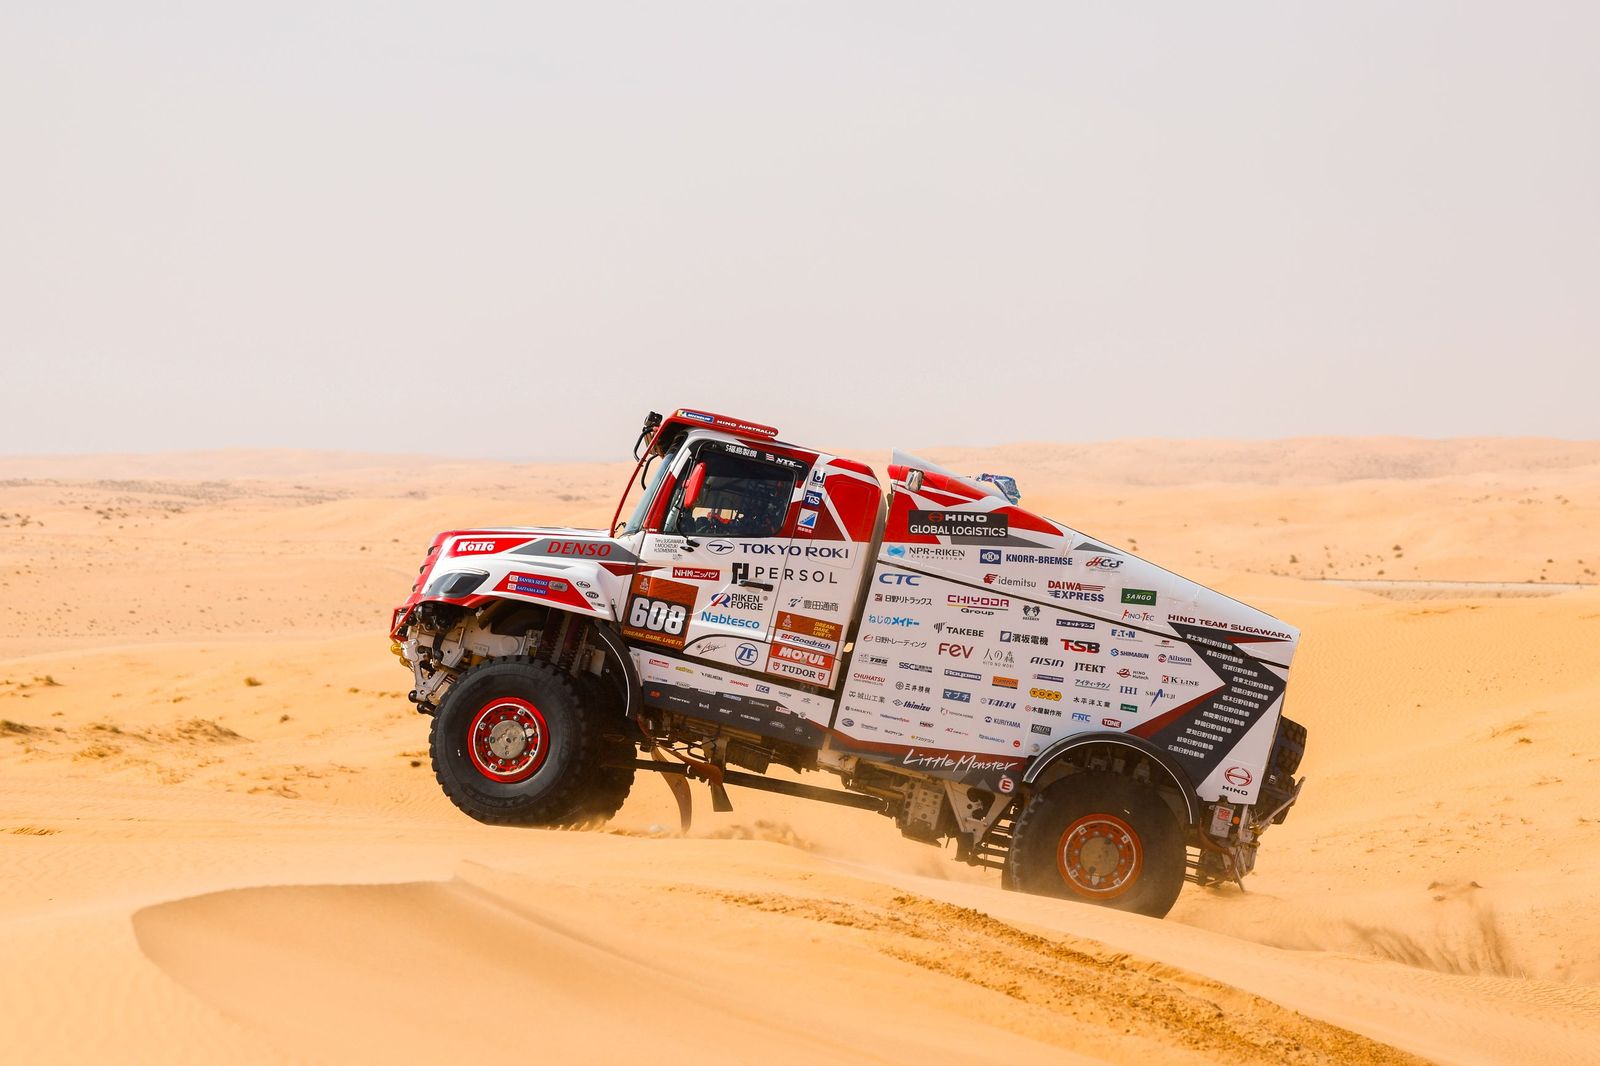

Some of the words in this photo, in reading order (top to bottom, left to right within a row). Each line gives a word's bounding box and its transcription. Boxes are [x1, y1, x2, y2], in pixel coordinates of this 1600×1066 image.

[717, 419, 737, 427] HINO
[738, 424, 776, 435] AUSTRALIA
[945, 514, 988, 522] HINO
[910, 524, 950, 535] GLOBAL
[951, 526, 1006, 537] LOGISTICS
[547, 540, 612, 557] DENSO
[739, 542, 802, 556] TOKYO
[806, 546, 849, 559] ROKI
[909, 547, 966, 557] NPR-RIKEN
[1006, 554, 1073, 566] KNORR-BREMSE
[755, 566, 838, 584] PERSOL
[879, 573, 922, 586] CTC
[998, 576, 1036, 588] idemitsu
[1048, 580, 1082, 591] DAIWA
[732, 593, 760, 603] RIKEN
[947, 594, 1009, 607] CHIYODA
[1054, 590, 1104, 602] EXPRESS
[730, 600, 763, 611] FORGE
[630, 597, 686, 634] 608
[701, 611, 760, 629] Nabtesco
[868, 615, 920, 627] ねじのメイドー
[946, 626, 984, 637] TAKEBE
[1168, 614, 1195, 623] HINO
[1199, 618, 1227, 629] TEAM
[1231, 624, 1292, 640] SUGAWARA
[623, 630, 644, 638] DREAM.
[1060, 639, 1100, 654] TSB
[738, 647, 757, 660] ZF
[778, 647, 825, 666] MOTUL
[1168, 655, 1192, 663] Allison
[899, 662, 915, 670] SSC
[1030, 656, 1064, 667] AISIN
[1074, 662, 1106, 673] JTEKT
[782, 664, 816, 678] TUDOR
[854, 672, 885, 682] CHUHATSU
[1120, 686, 1137, 695] IHI
[904, 700, 931, 712] Shimizu
[994, 718, 1021, 728] KURIYAMA
[1103, 719, 1120, 727] TONE
[903, 748, 956, 768] Little
[953, 754, 1018, 773] Monster
[1001, 779, 1012, 790] E
[1222, 785, 1248, 796] HINO
